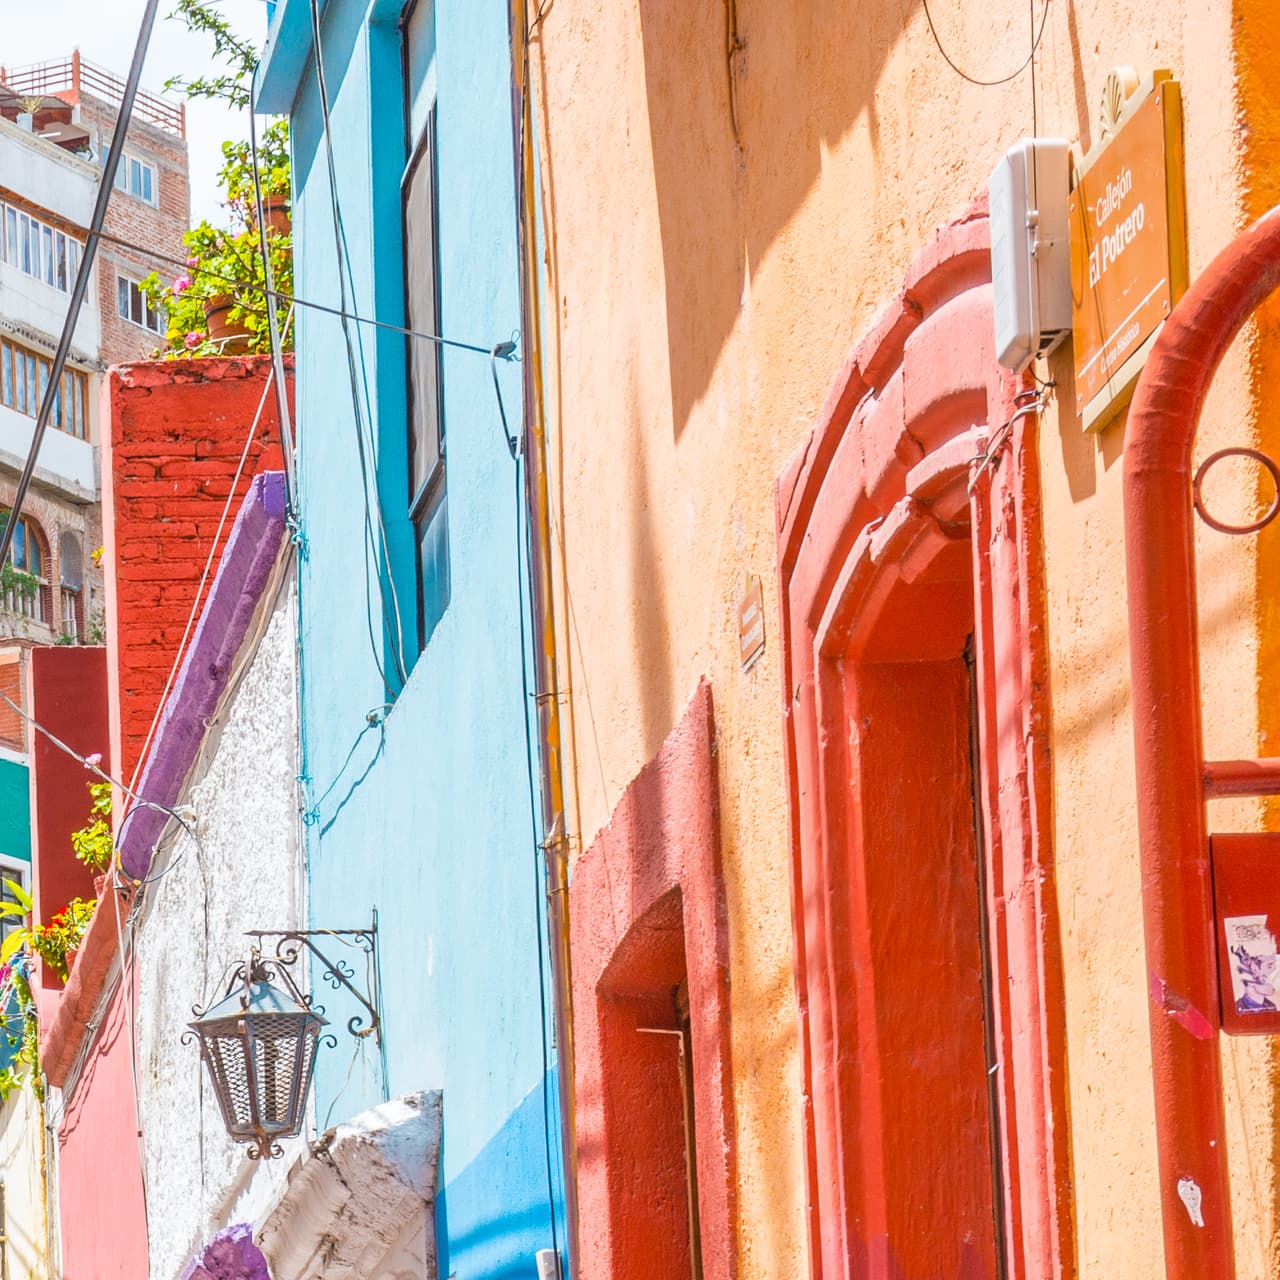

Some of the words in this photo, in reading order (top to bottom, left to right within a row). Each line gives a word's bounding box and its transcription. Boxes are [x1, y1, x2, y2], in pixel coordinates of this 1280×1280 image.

[1096, 167, 1132, 227] Callejón
[1089, 242, 1101, 289] El
[1102, 202, 1144, 273] Potrero
